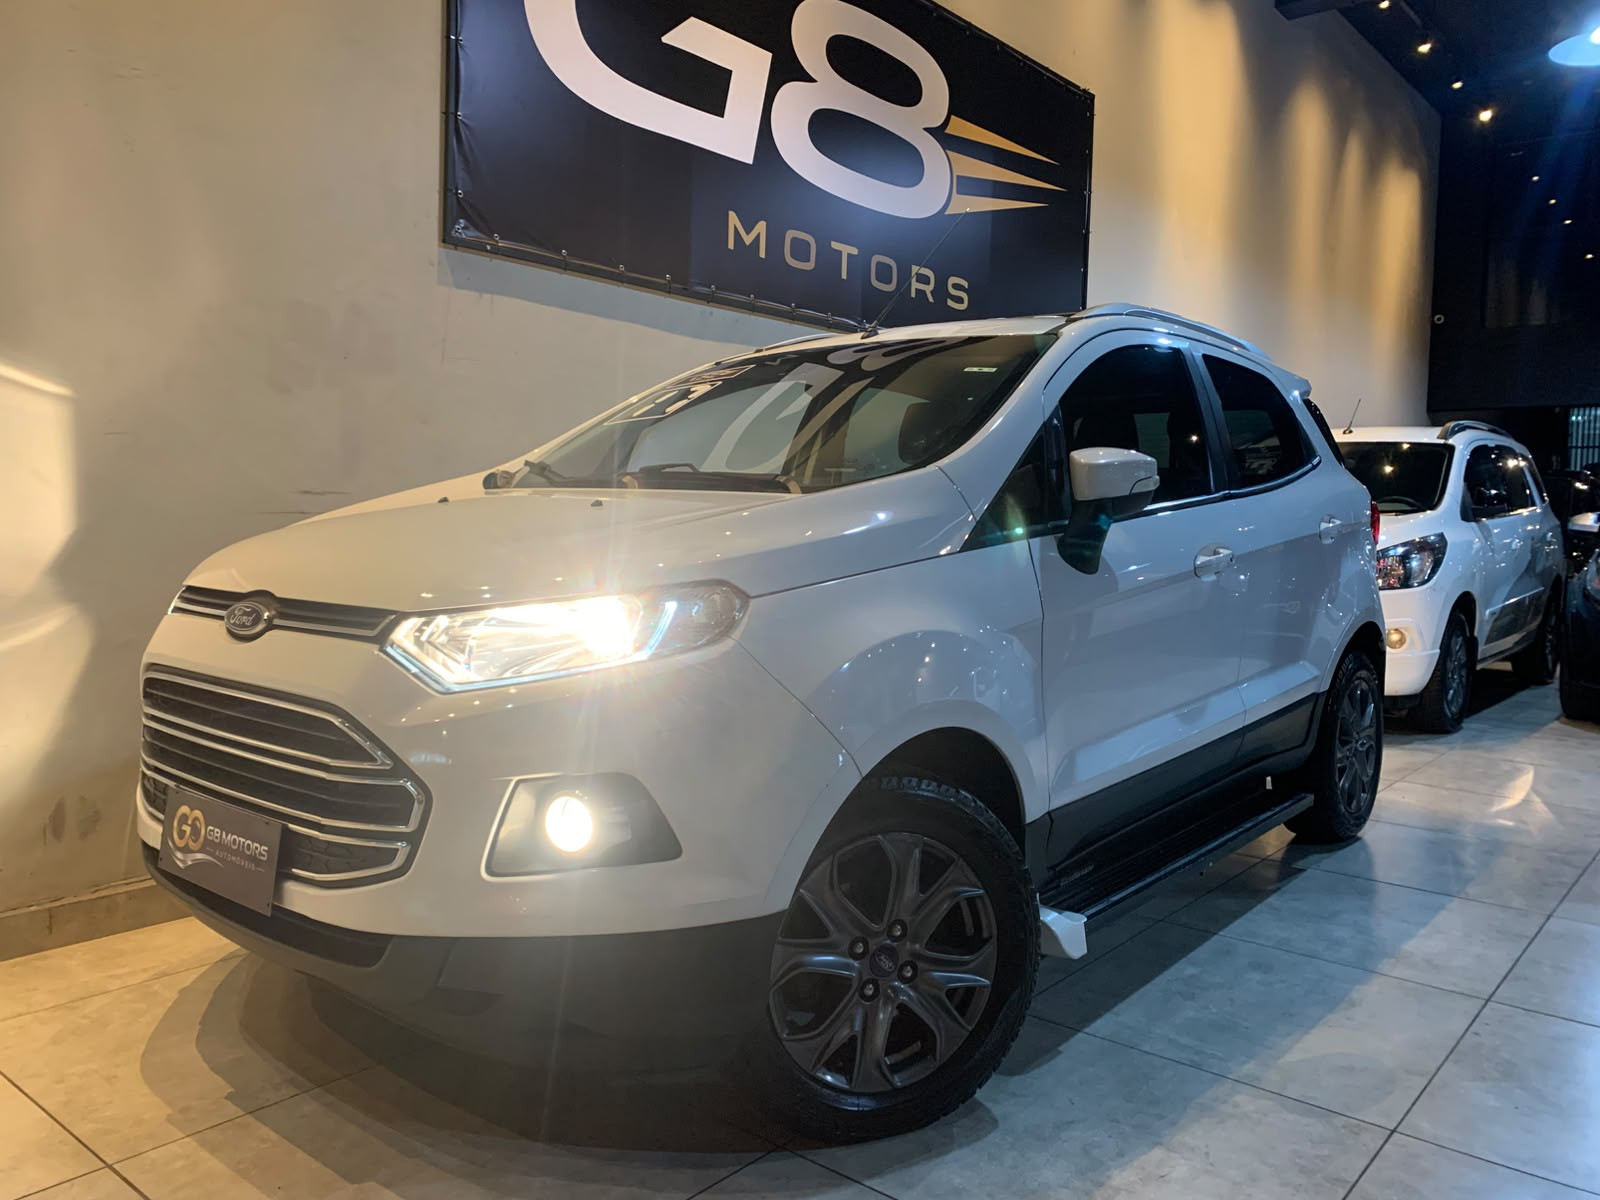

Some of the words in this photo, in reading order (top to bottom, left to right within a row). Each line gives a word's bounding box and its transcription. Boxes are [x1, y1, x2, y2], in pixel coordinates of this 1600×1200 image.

[524, 0, 951, 219] G8
[727, 210, 970, 311] MOTORS
[230, 606, 257, 626] Ford
[221, 831, 268, 861] MOTORS
